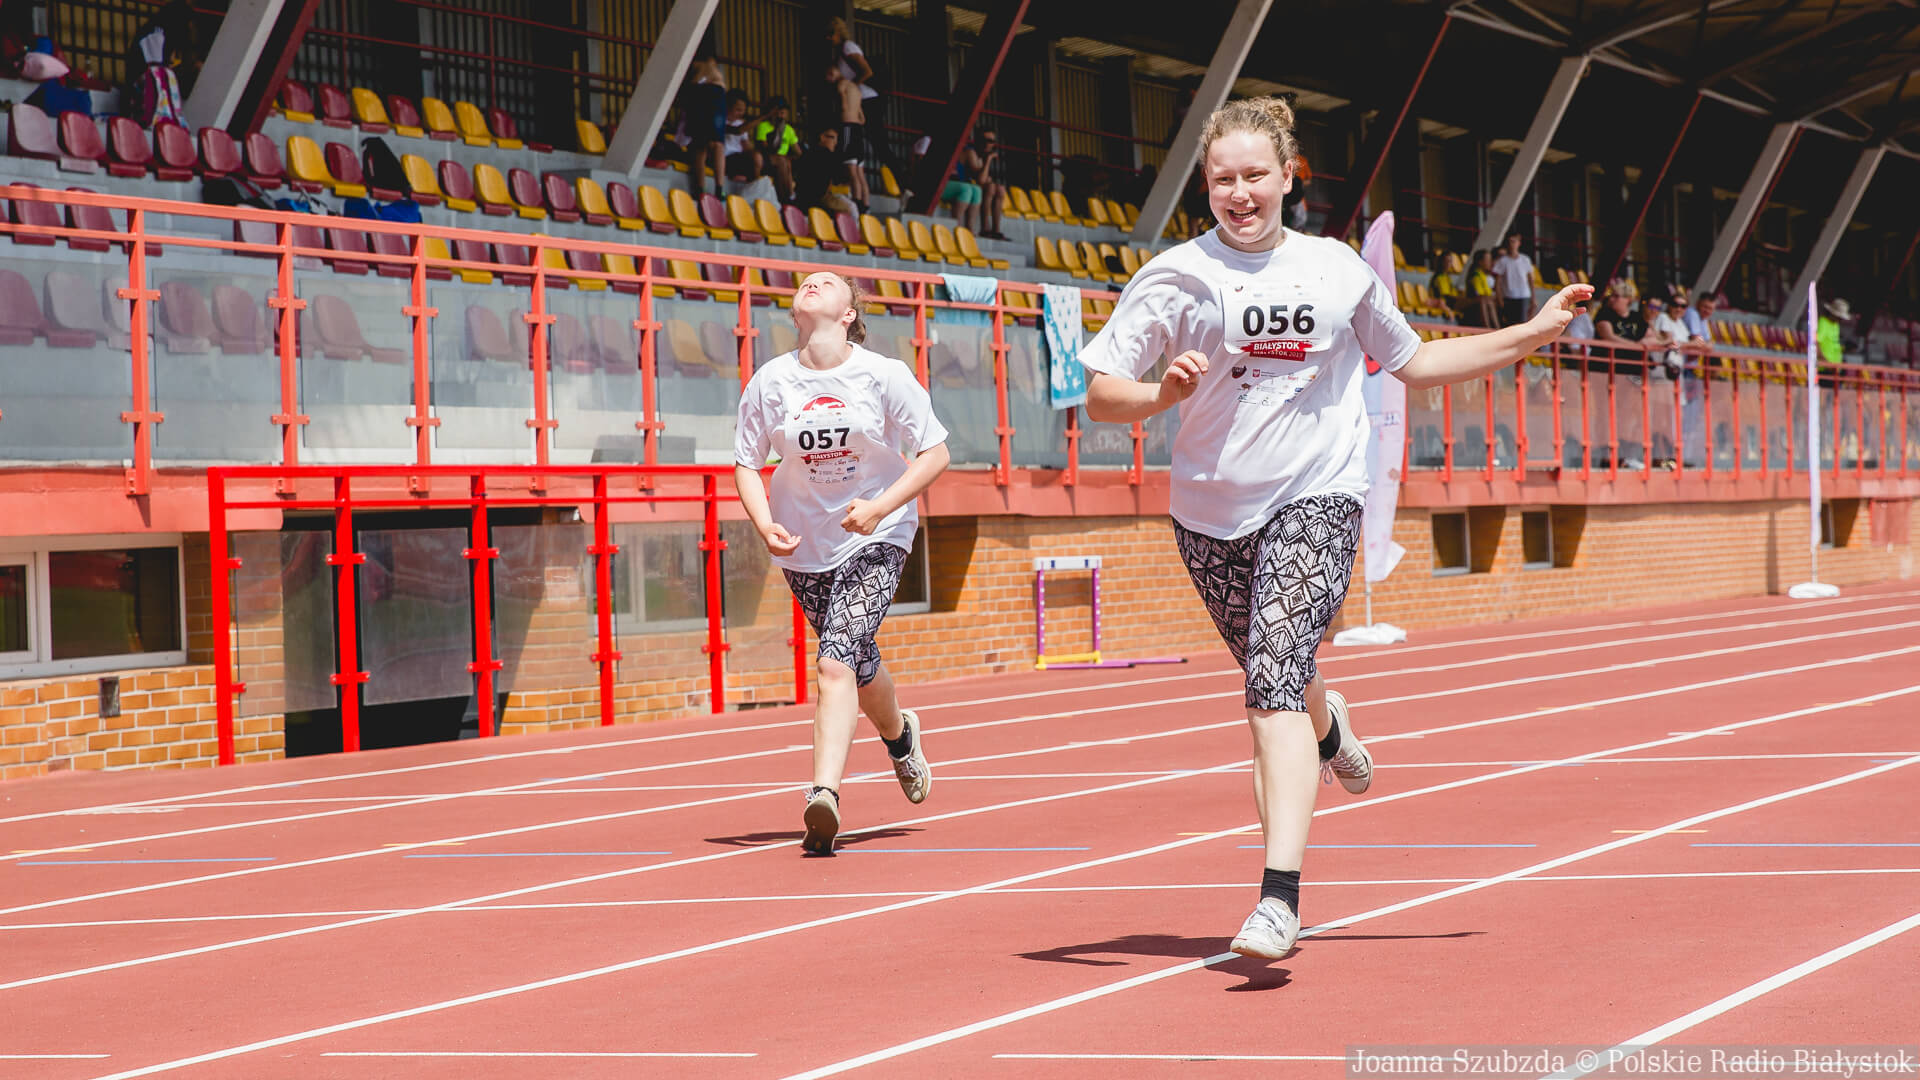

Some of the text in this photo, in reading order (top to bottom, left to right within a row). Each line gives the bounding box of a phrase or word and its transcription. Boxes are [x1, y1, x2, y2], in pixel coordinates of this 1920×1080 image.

[1243, 304, 1315, 336] 056
[1254, 342, 1299, 351] BIAŁYSTOK
[798, 427, 850, 450] 057
